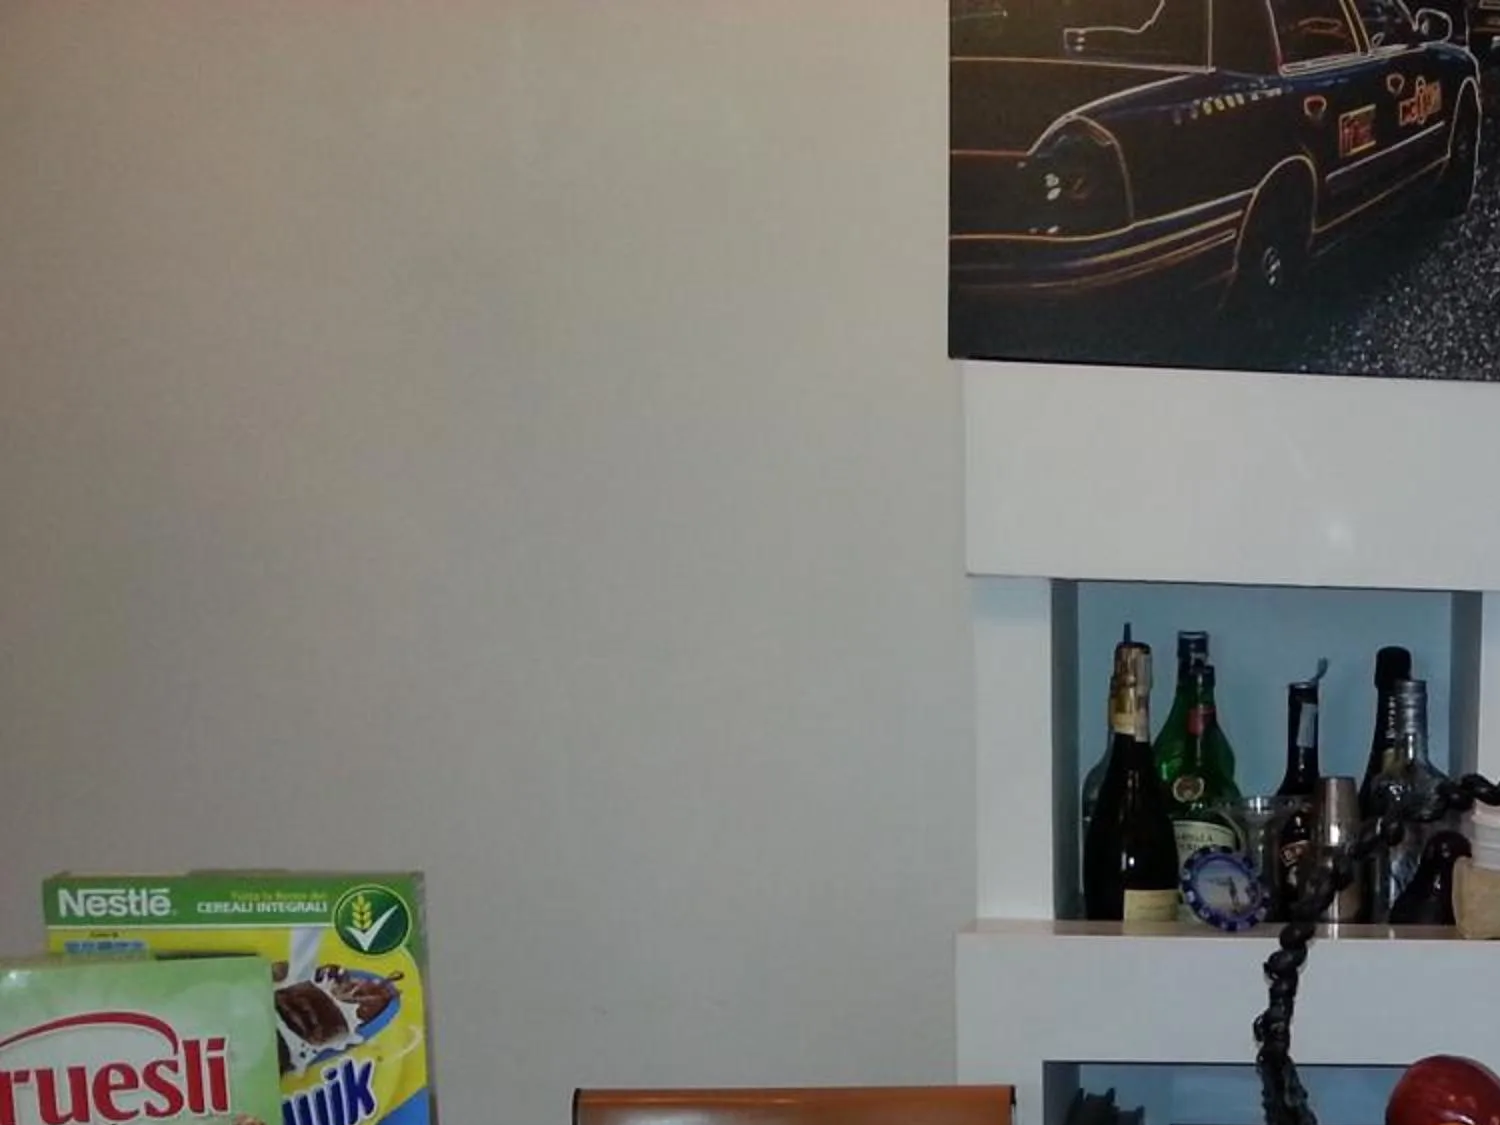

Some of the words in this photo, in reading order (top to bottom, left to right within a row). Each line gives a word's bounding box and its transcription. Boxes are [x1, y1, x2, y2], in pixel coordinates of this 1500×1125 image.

[58, 888, 171, 917] Nestlé
[197, 902, 253, 913] CEREALI
[256, 901, 328, 913] INTEGRALI
